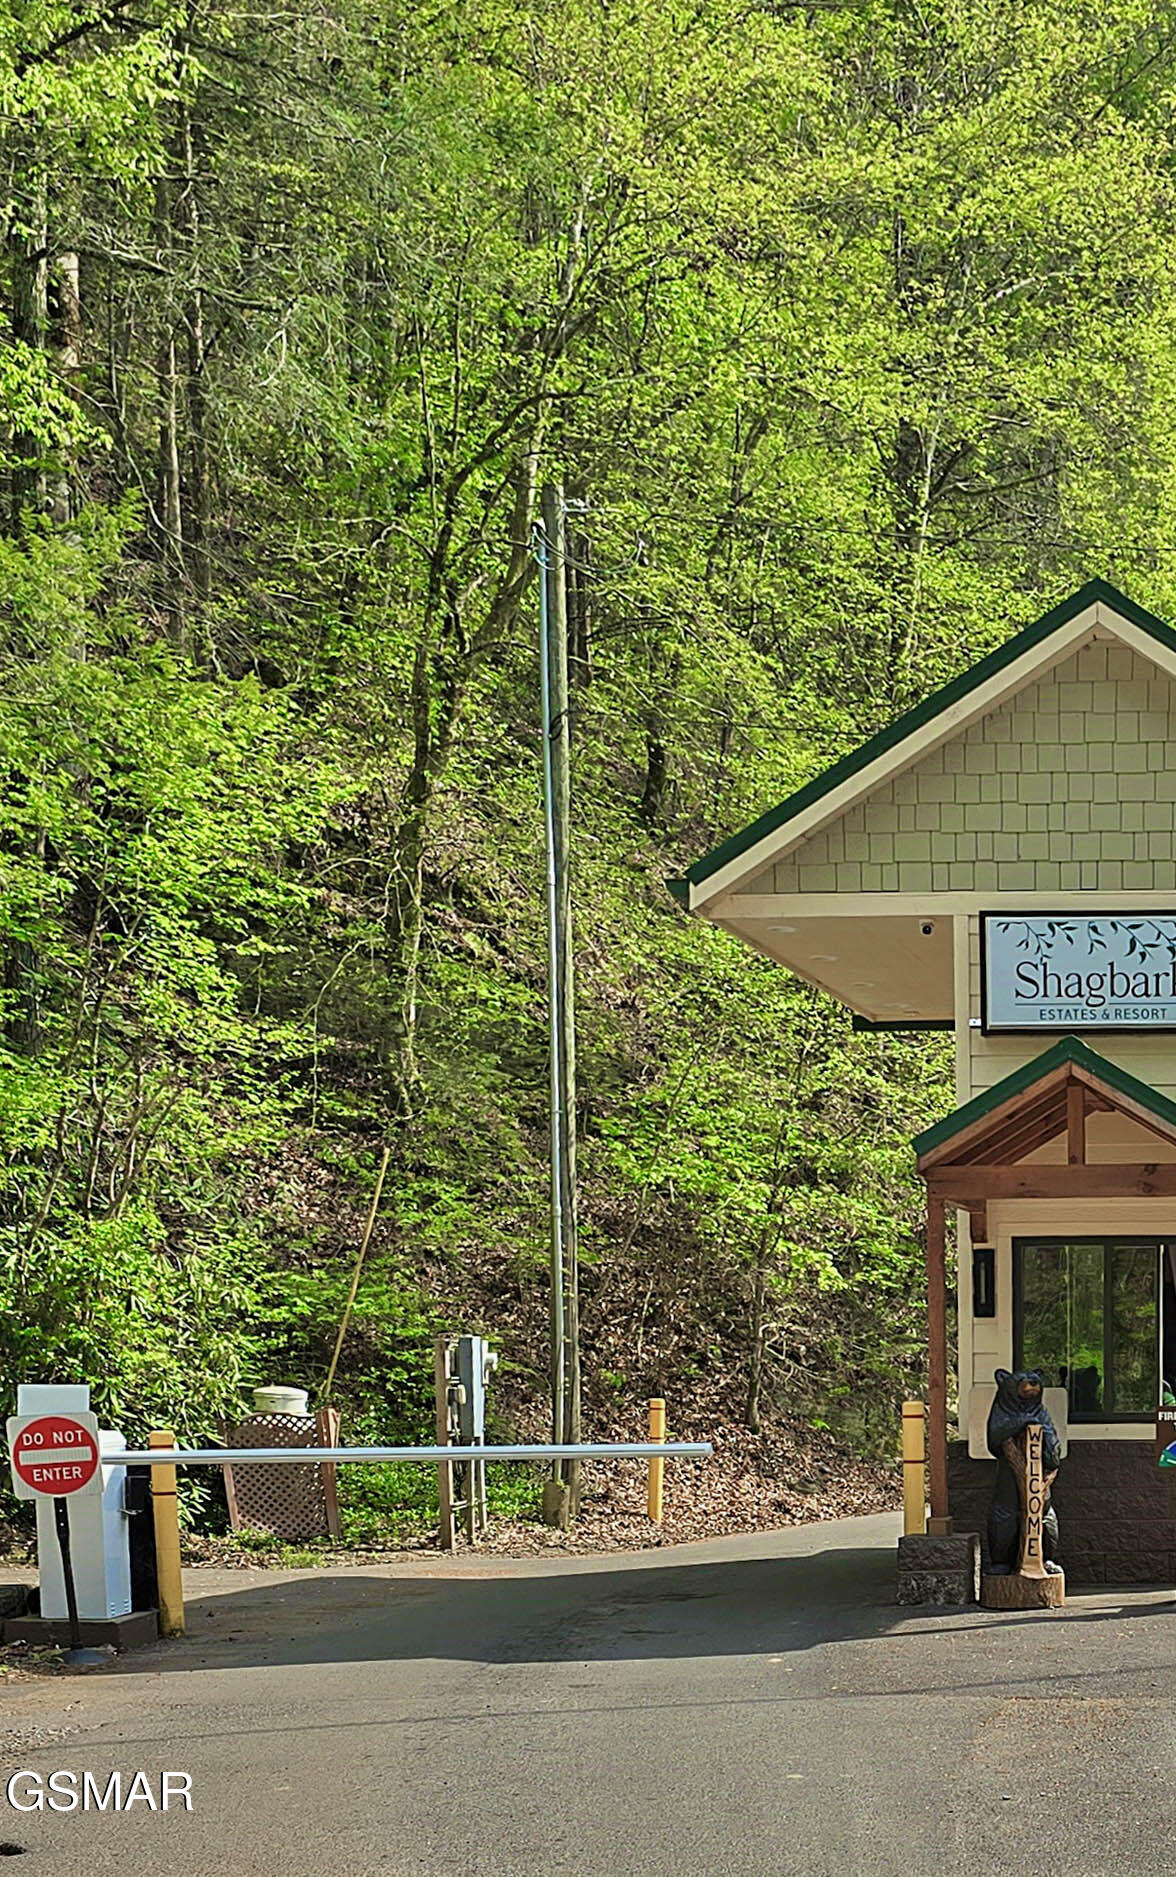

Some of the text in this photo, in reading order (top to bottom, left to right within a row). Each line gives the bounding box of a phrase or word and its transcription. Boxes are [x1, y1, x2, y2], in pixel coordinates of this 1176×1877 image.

[1039, 1007, 1168, 1021] ESTATES & RESORT
[22, 1430, 84, 1447] DO NOT
[32, 1466, 83, 1482] ENTER
[1027, 1426, 1043, 1557] WELCOME
